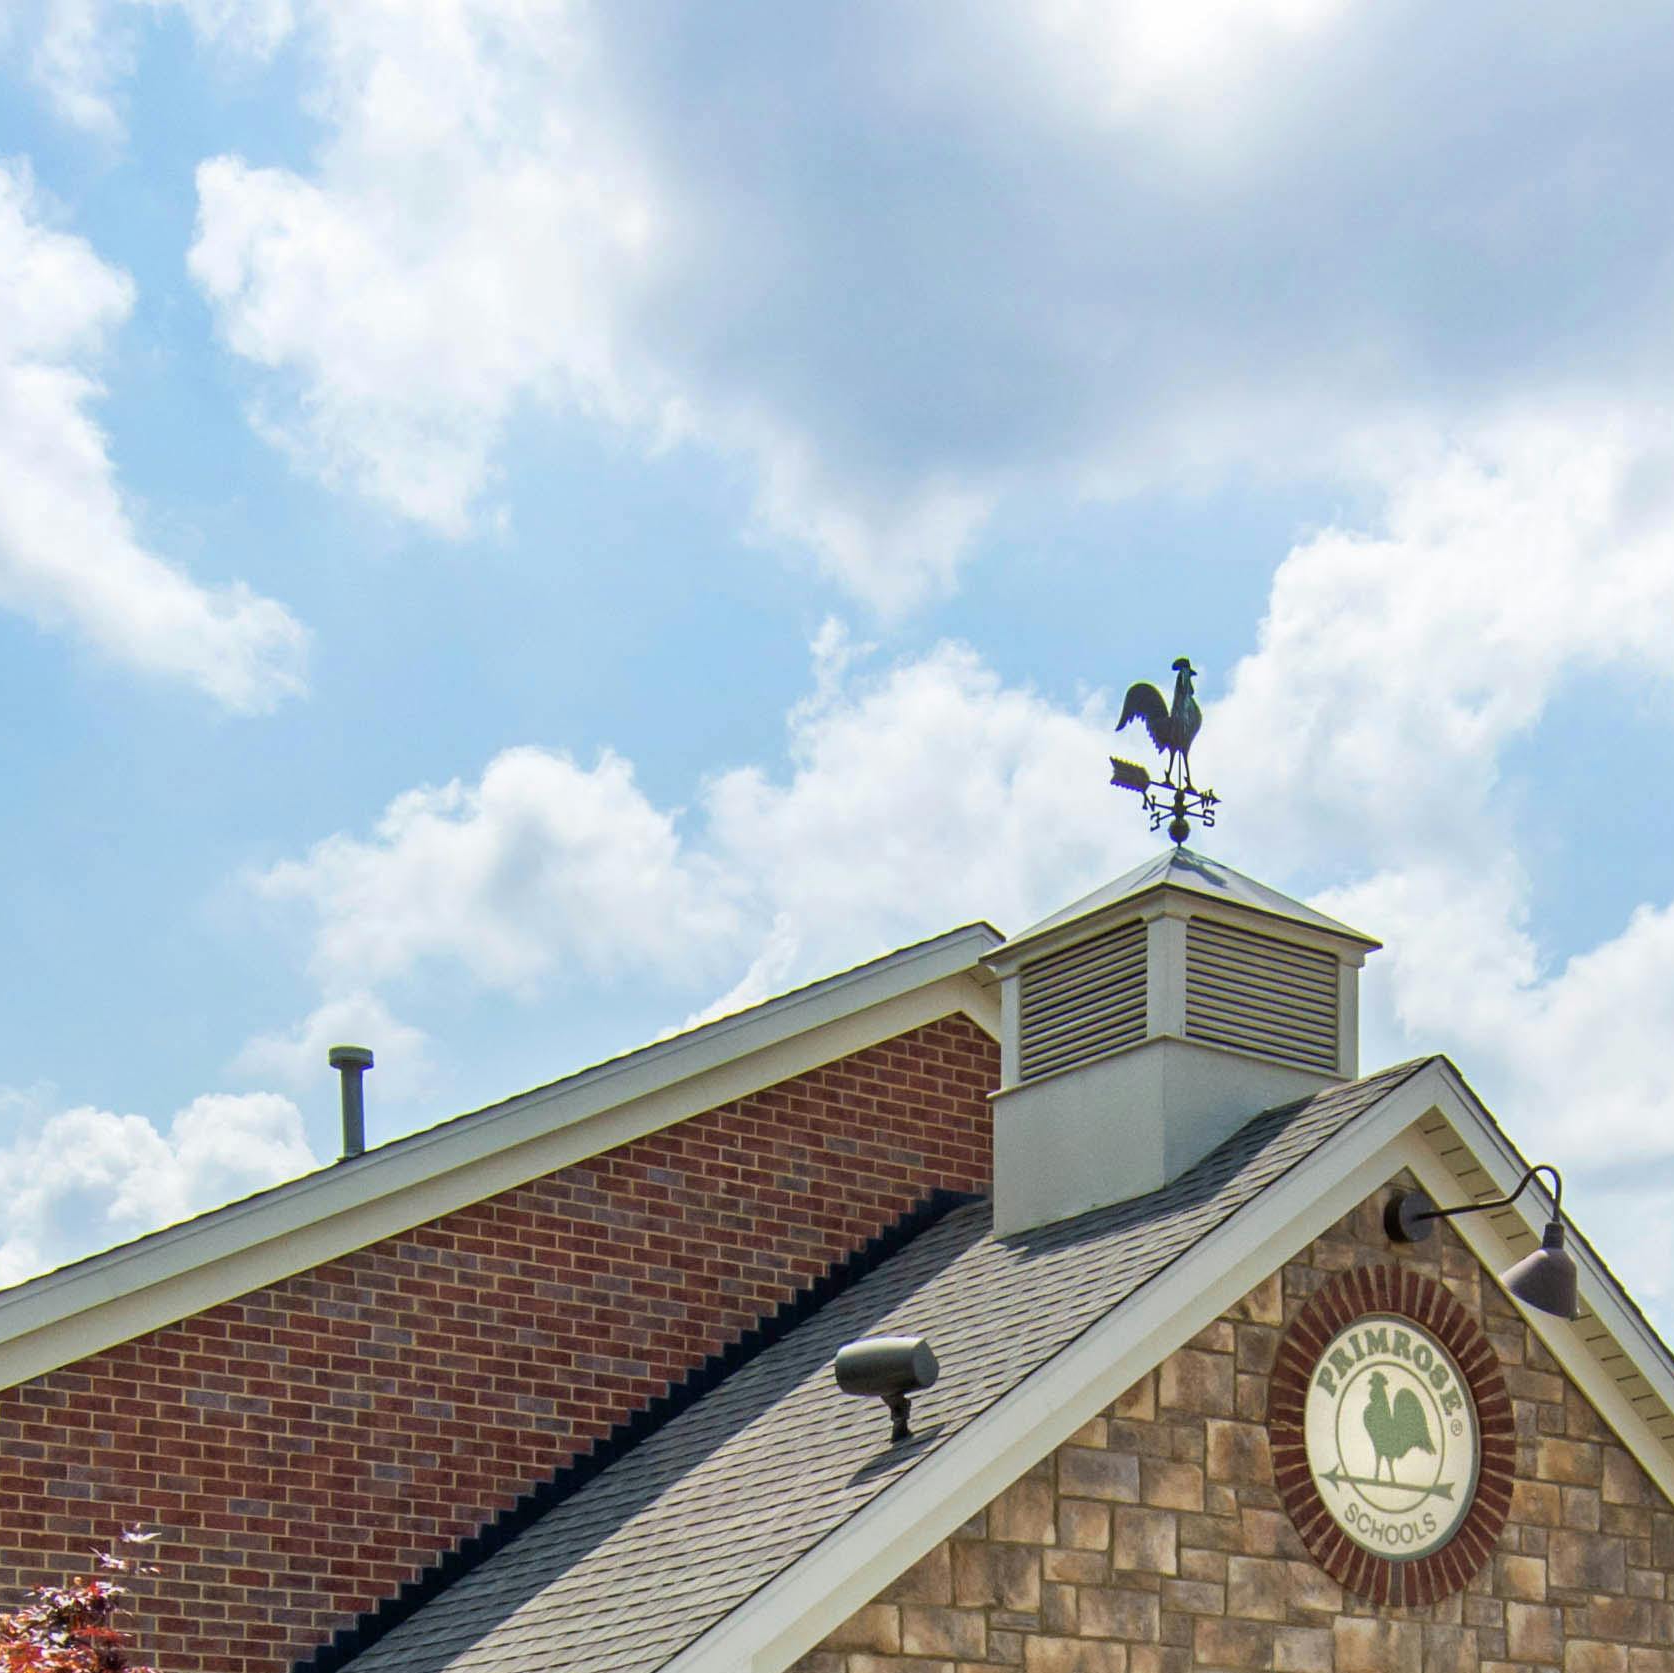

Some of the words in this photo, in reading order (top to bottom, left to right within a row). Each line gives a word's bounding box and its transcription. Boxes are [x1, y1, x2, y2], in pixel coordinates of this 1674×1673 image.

[1142, 794, 1156, 812] N
[1203, 809, 1215, 828] S
[1316, 1327, 1463, 1417] PRIMROSE
[1344, 1502, 1437, 1546] SCHOOLS
